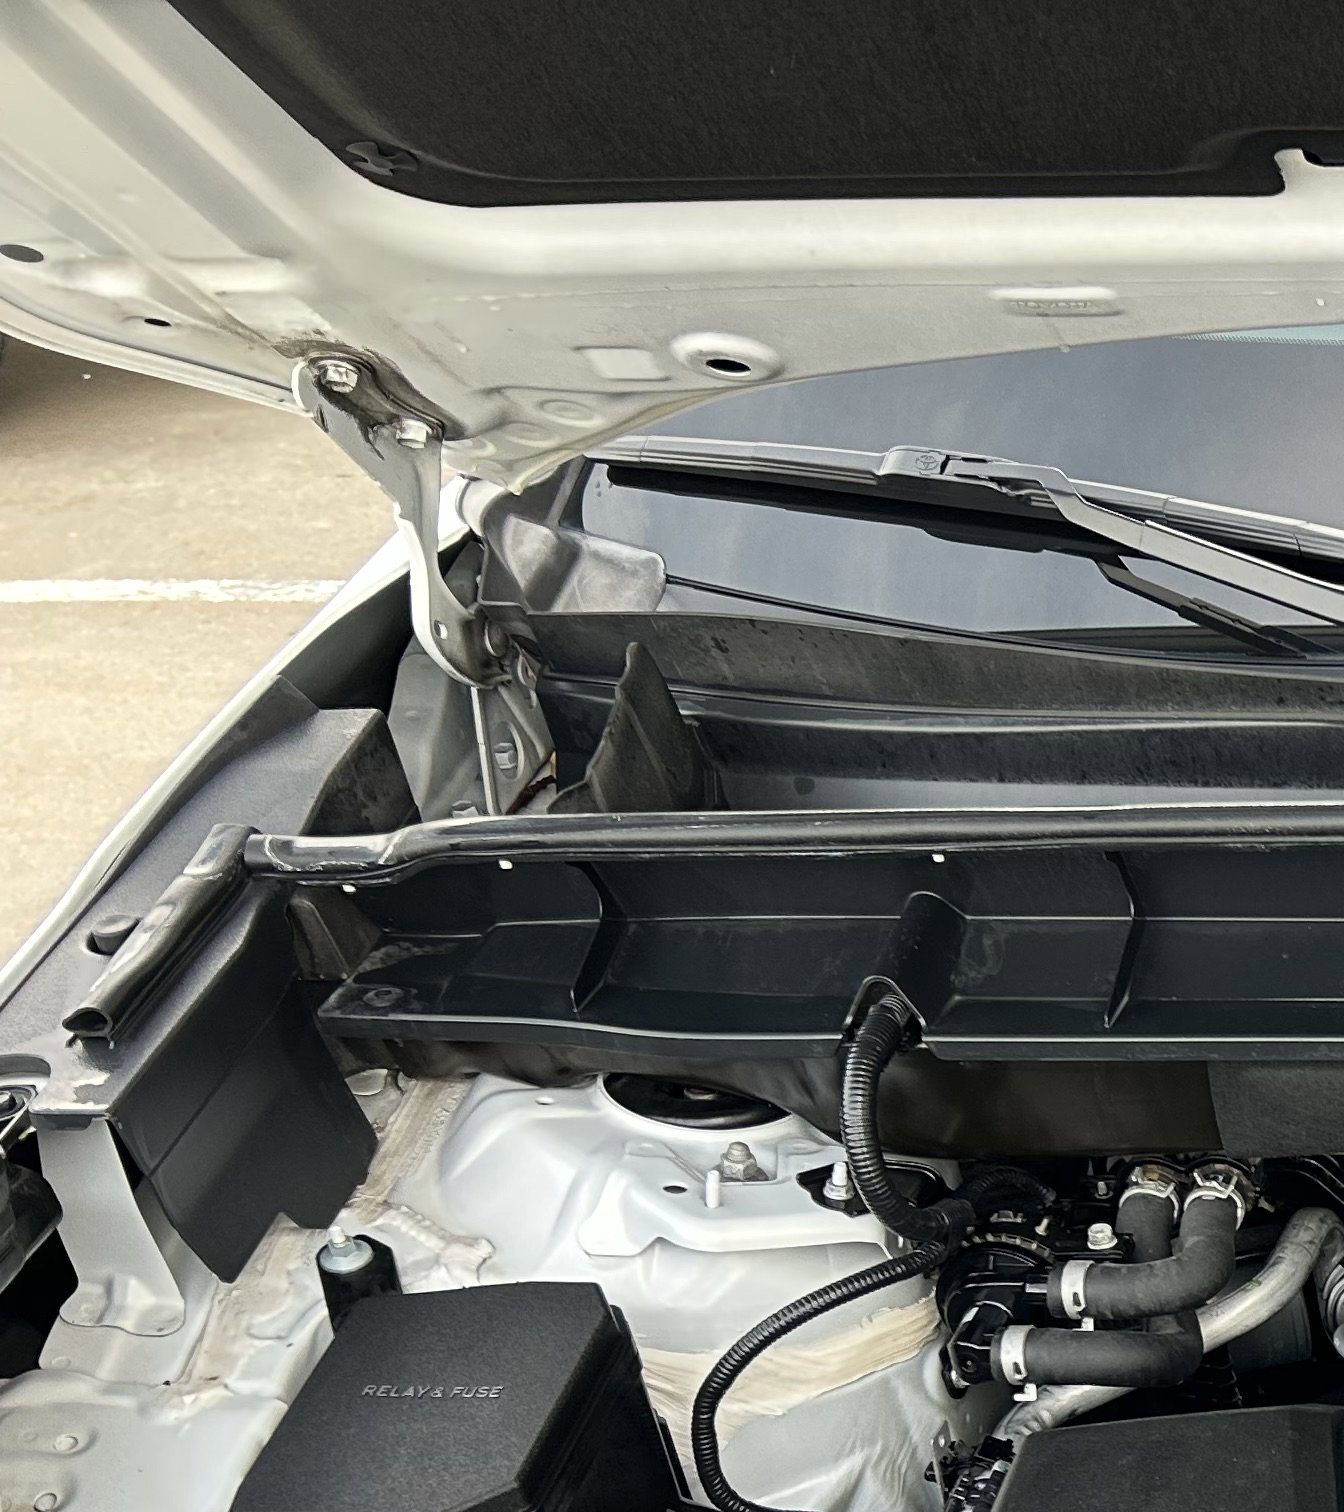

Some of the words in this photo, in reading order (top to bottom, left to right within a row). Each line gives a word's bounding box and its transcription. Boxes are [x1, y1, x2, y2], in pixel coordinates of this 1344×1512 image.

[361, 1384, 431, 1398] RELAY
[429, 1387, 444, 1399] &
[449, 1385, 504, 1399] FUSE
